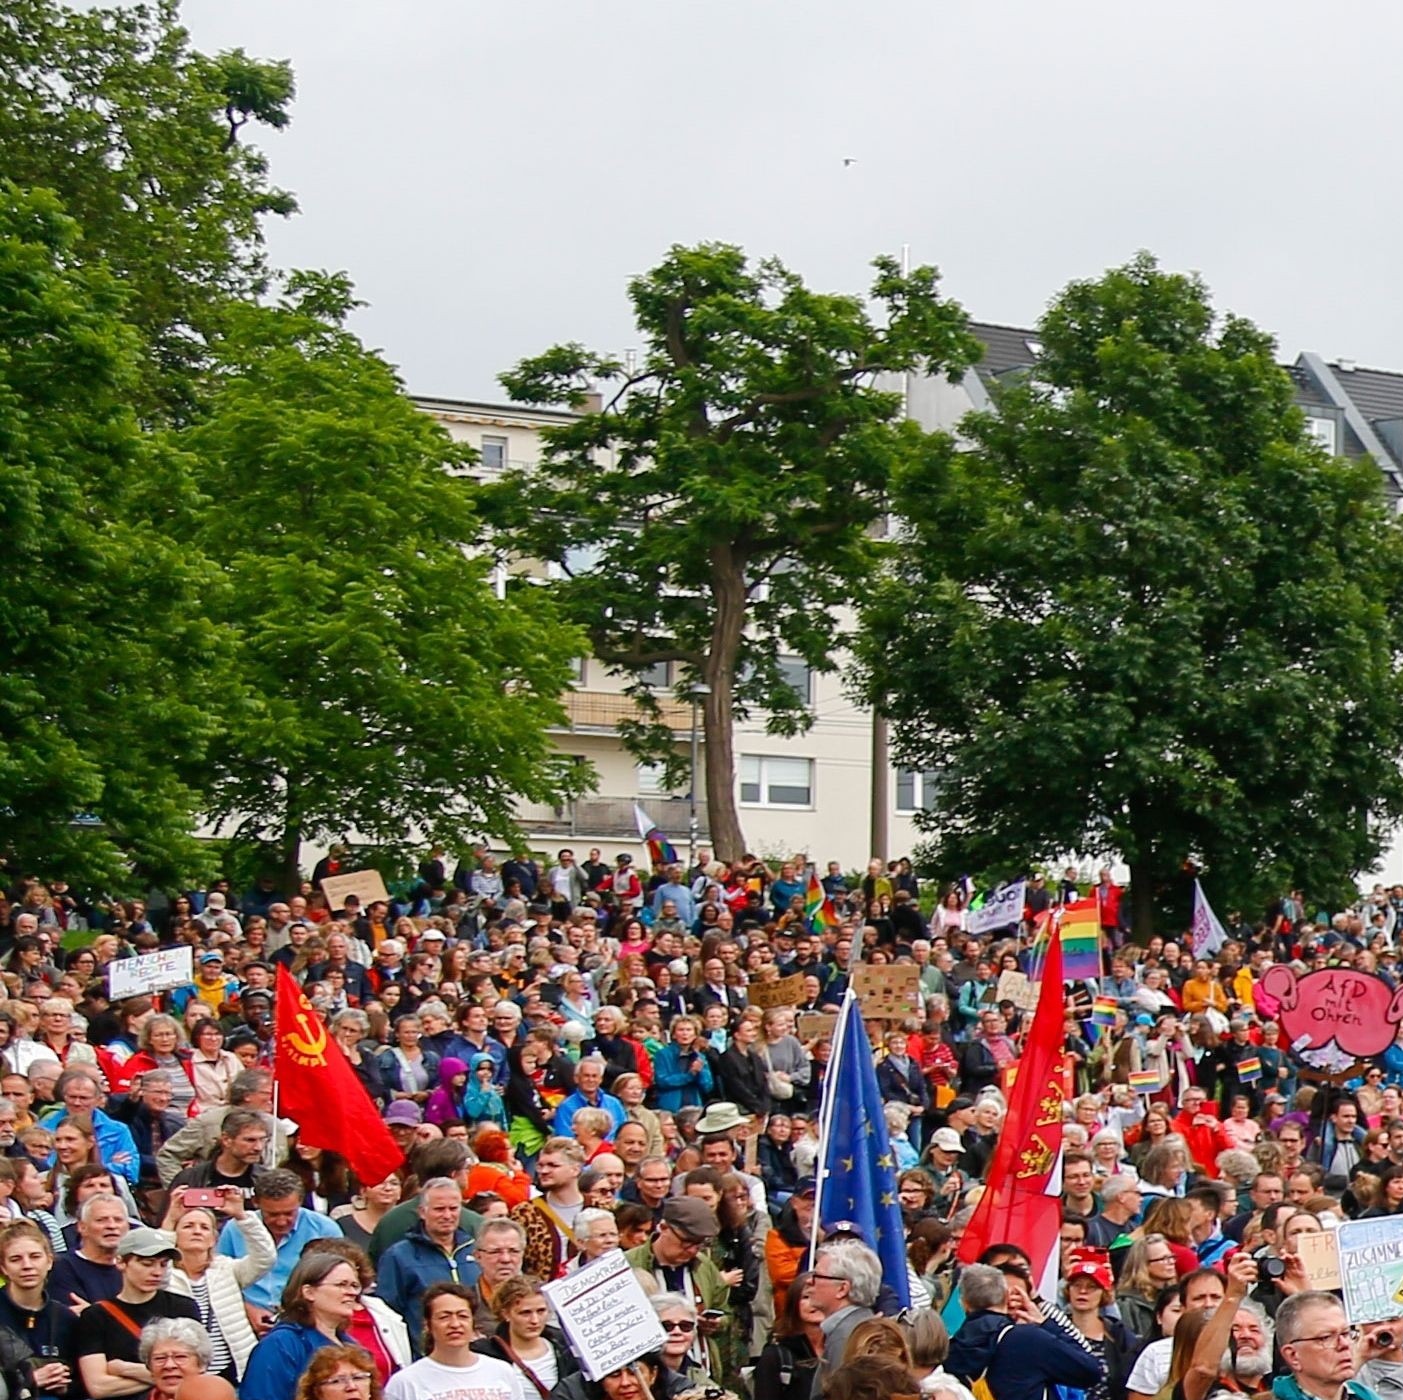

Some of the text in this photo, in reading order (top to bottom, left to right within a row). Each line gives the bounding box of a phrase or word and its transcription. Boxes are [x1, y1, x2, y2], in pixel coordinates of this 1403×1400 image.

[1317, 975, 1367, 998] AfD
[1325, 998, 1352, 1011] mit
[1311, 1007, 1362, 1025] Ohren
